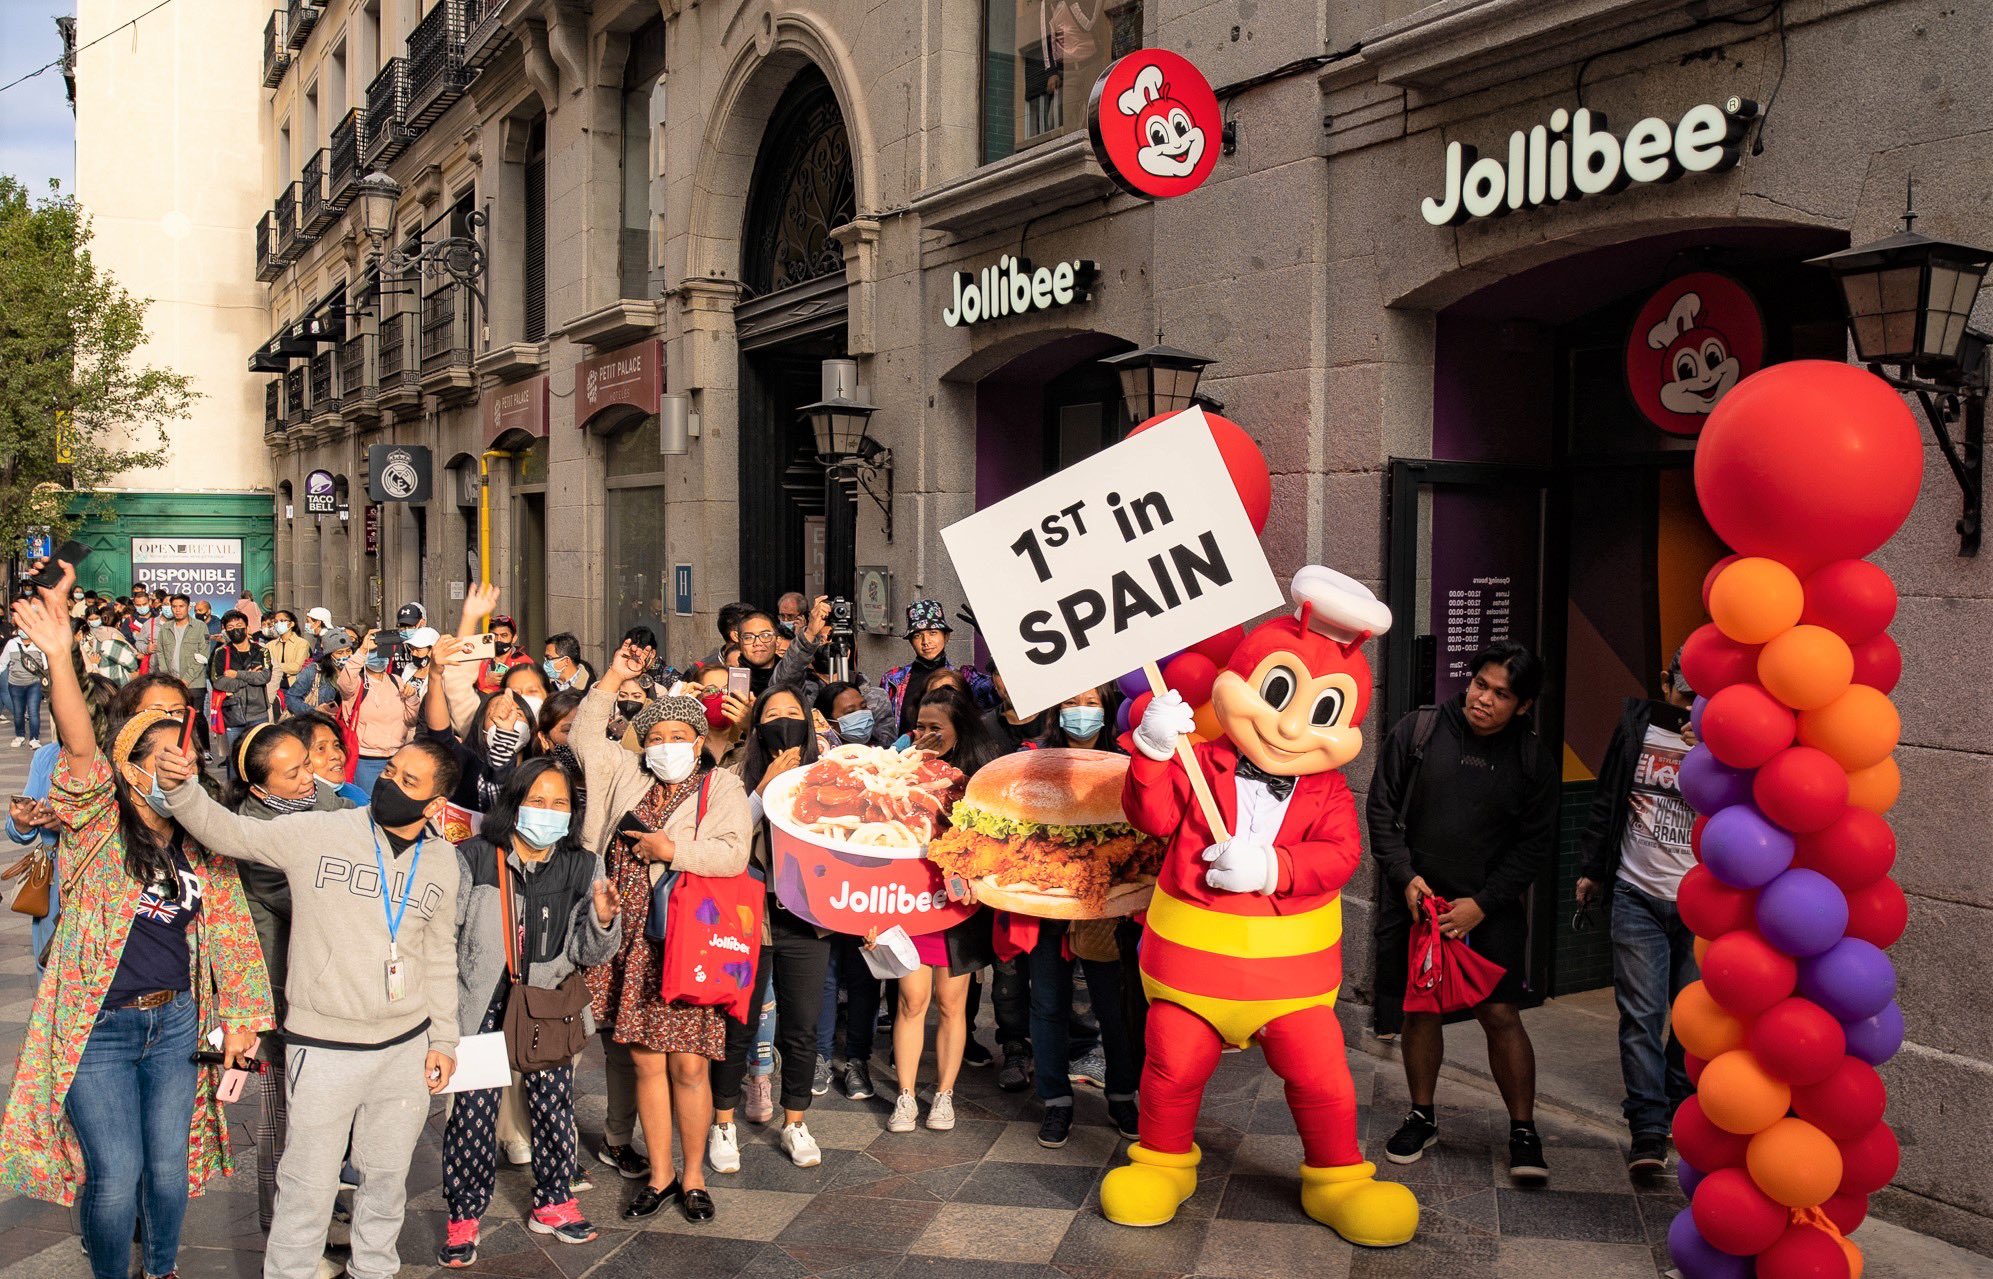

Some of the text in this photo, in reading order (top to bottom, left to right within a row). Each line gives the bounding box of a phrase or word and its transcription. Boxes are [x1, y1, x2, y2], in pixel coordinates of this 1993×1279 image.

[1421, 104, 1727, 225] Jollibee
[943, 254, 1074, 327] Jollibee
[600, 355, 641, 381] PETIT PALACE
[307, 495, 334, 503] TACO
[309, 503, 334, 511] BELL
[139, 544, 235, 554] OPEN RETAIL
[1010, 491, 1174, 583] 1ST in
[138, 568, 236, 582] DISPONIBLE
[1019, 530, 1233, 665] SPAIN
[315, 855, 444, 919] POLO
[829, 880, 947, 915] Jollibee
